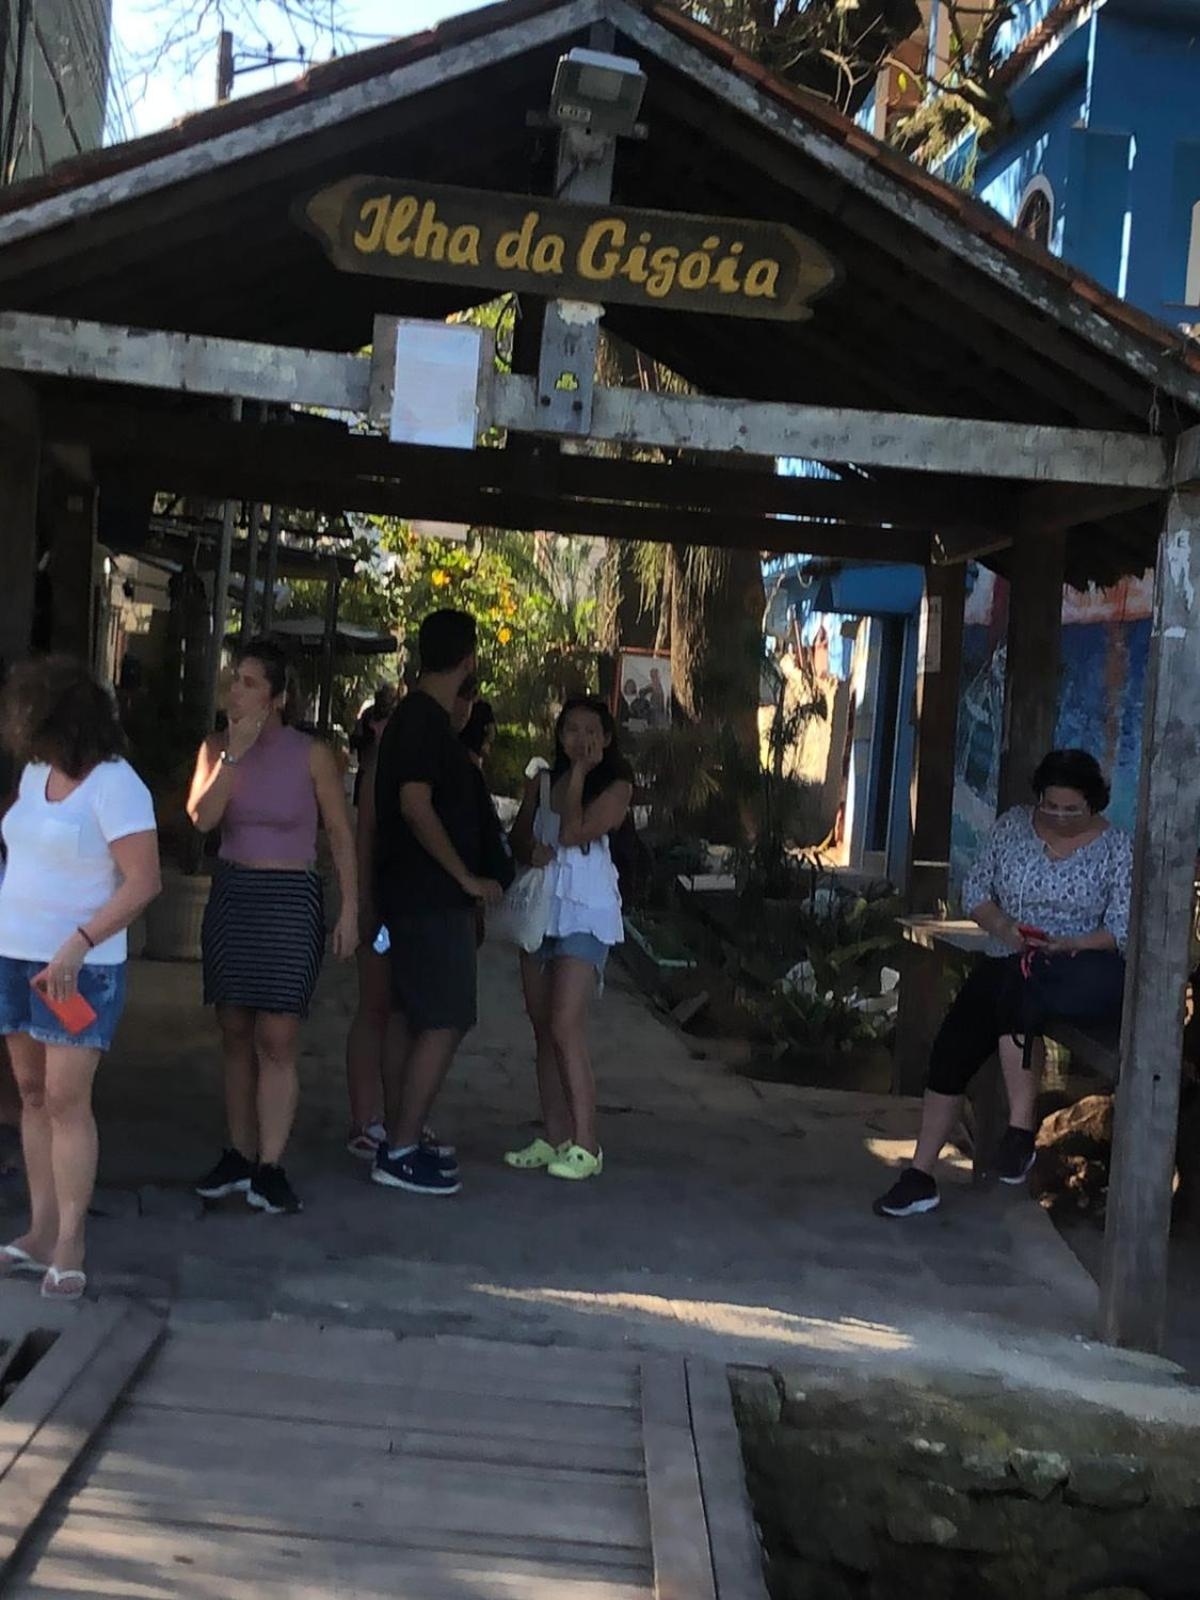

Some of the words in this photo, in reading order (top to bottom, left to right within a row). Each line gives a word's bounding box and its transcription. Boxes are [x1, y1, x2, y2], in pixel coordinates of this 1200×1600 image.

[354, 194, 480, 265] Ilha
[495, 211, 565, 273] da
[577, 218, 779, 298] Gigóia
